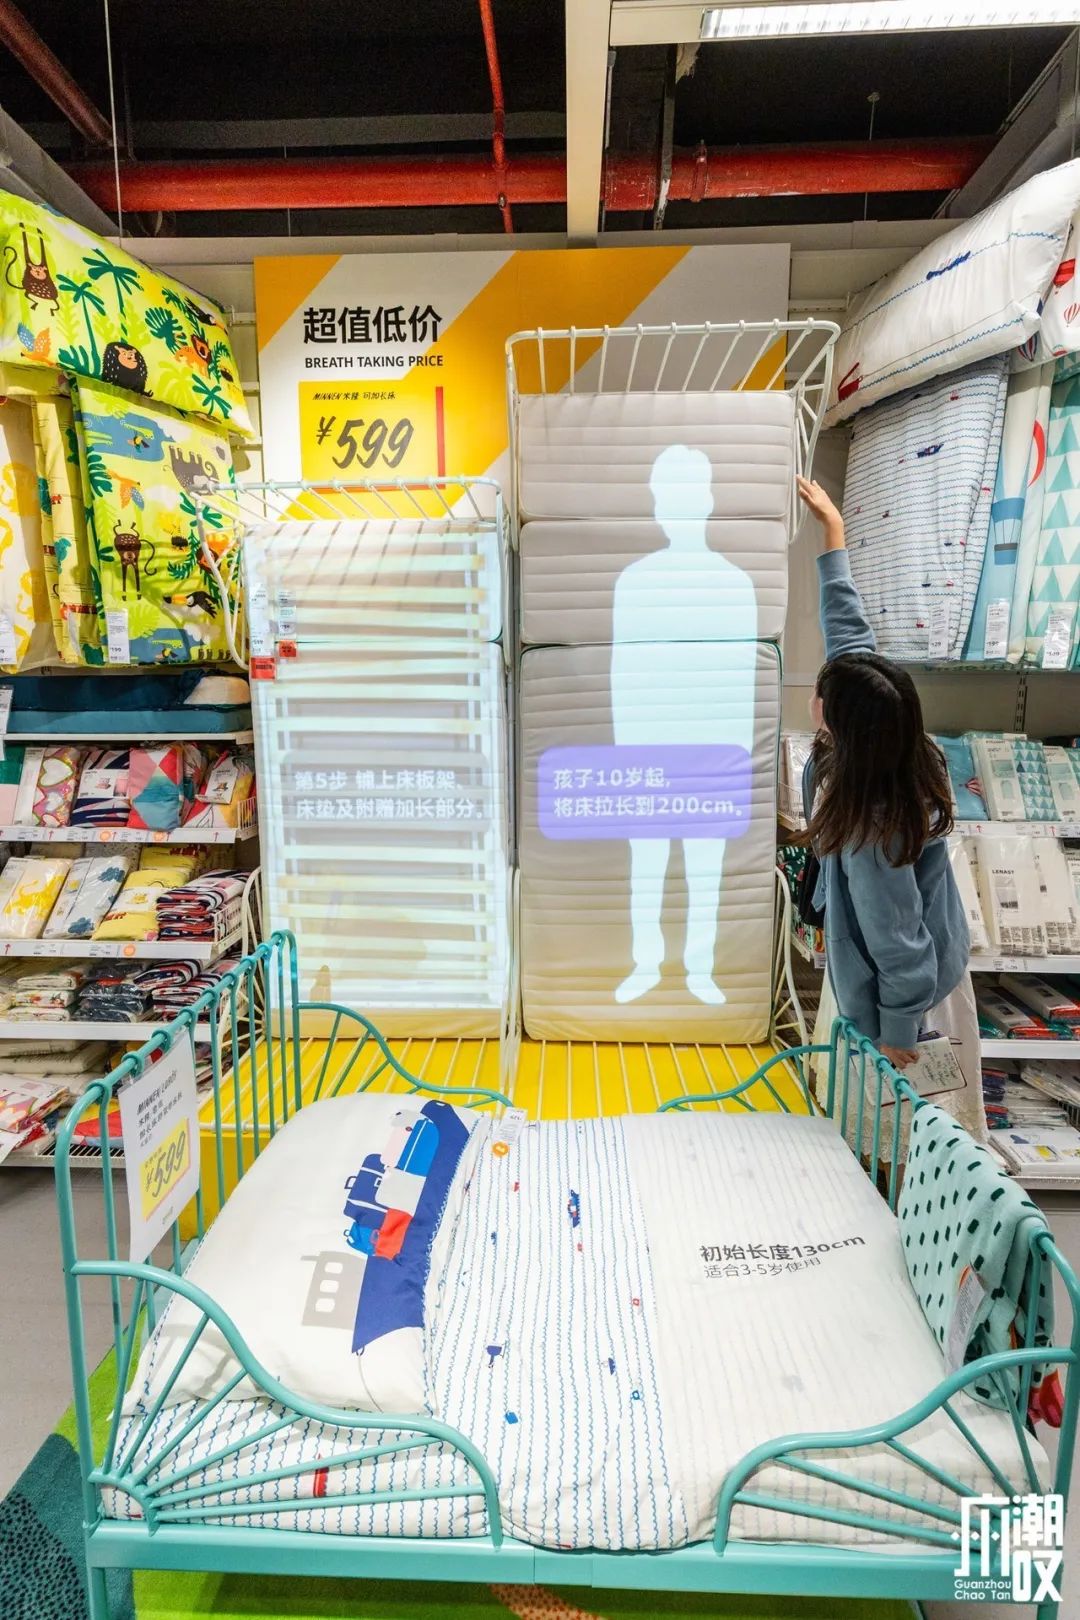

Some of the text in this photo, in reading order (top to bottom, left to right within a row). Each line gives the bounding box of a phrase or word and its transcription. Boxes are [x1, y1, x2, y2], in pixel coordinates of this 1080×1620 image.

[303, 304, 442, 344] 超值低价
[304, 354, 444, 369] BREATH TAKING PRICE
[295, 770, 348, 791] 第5步
[700, 1236, 866, 1263] 初始长度130cm
